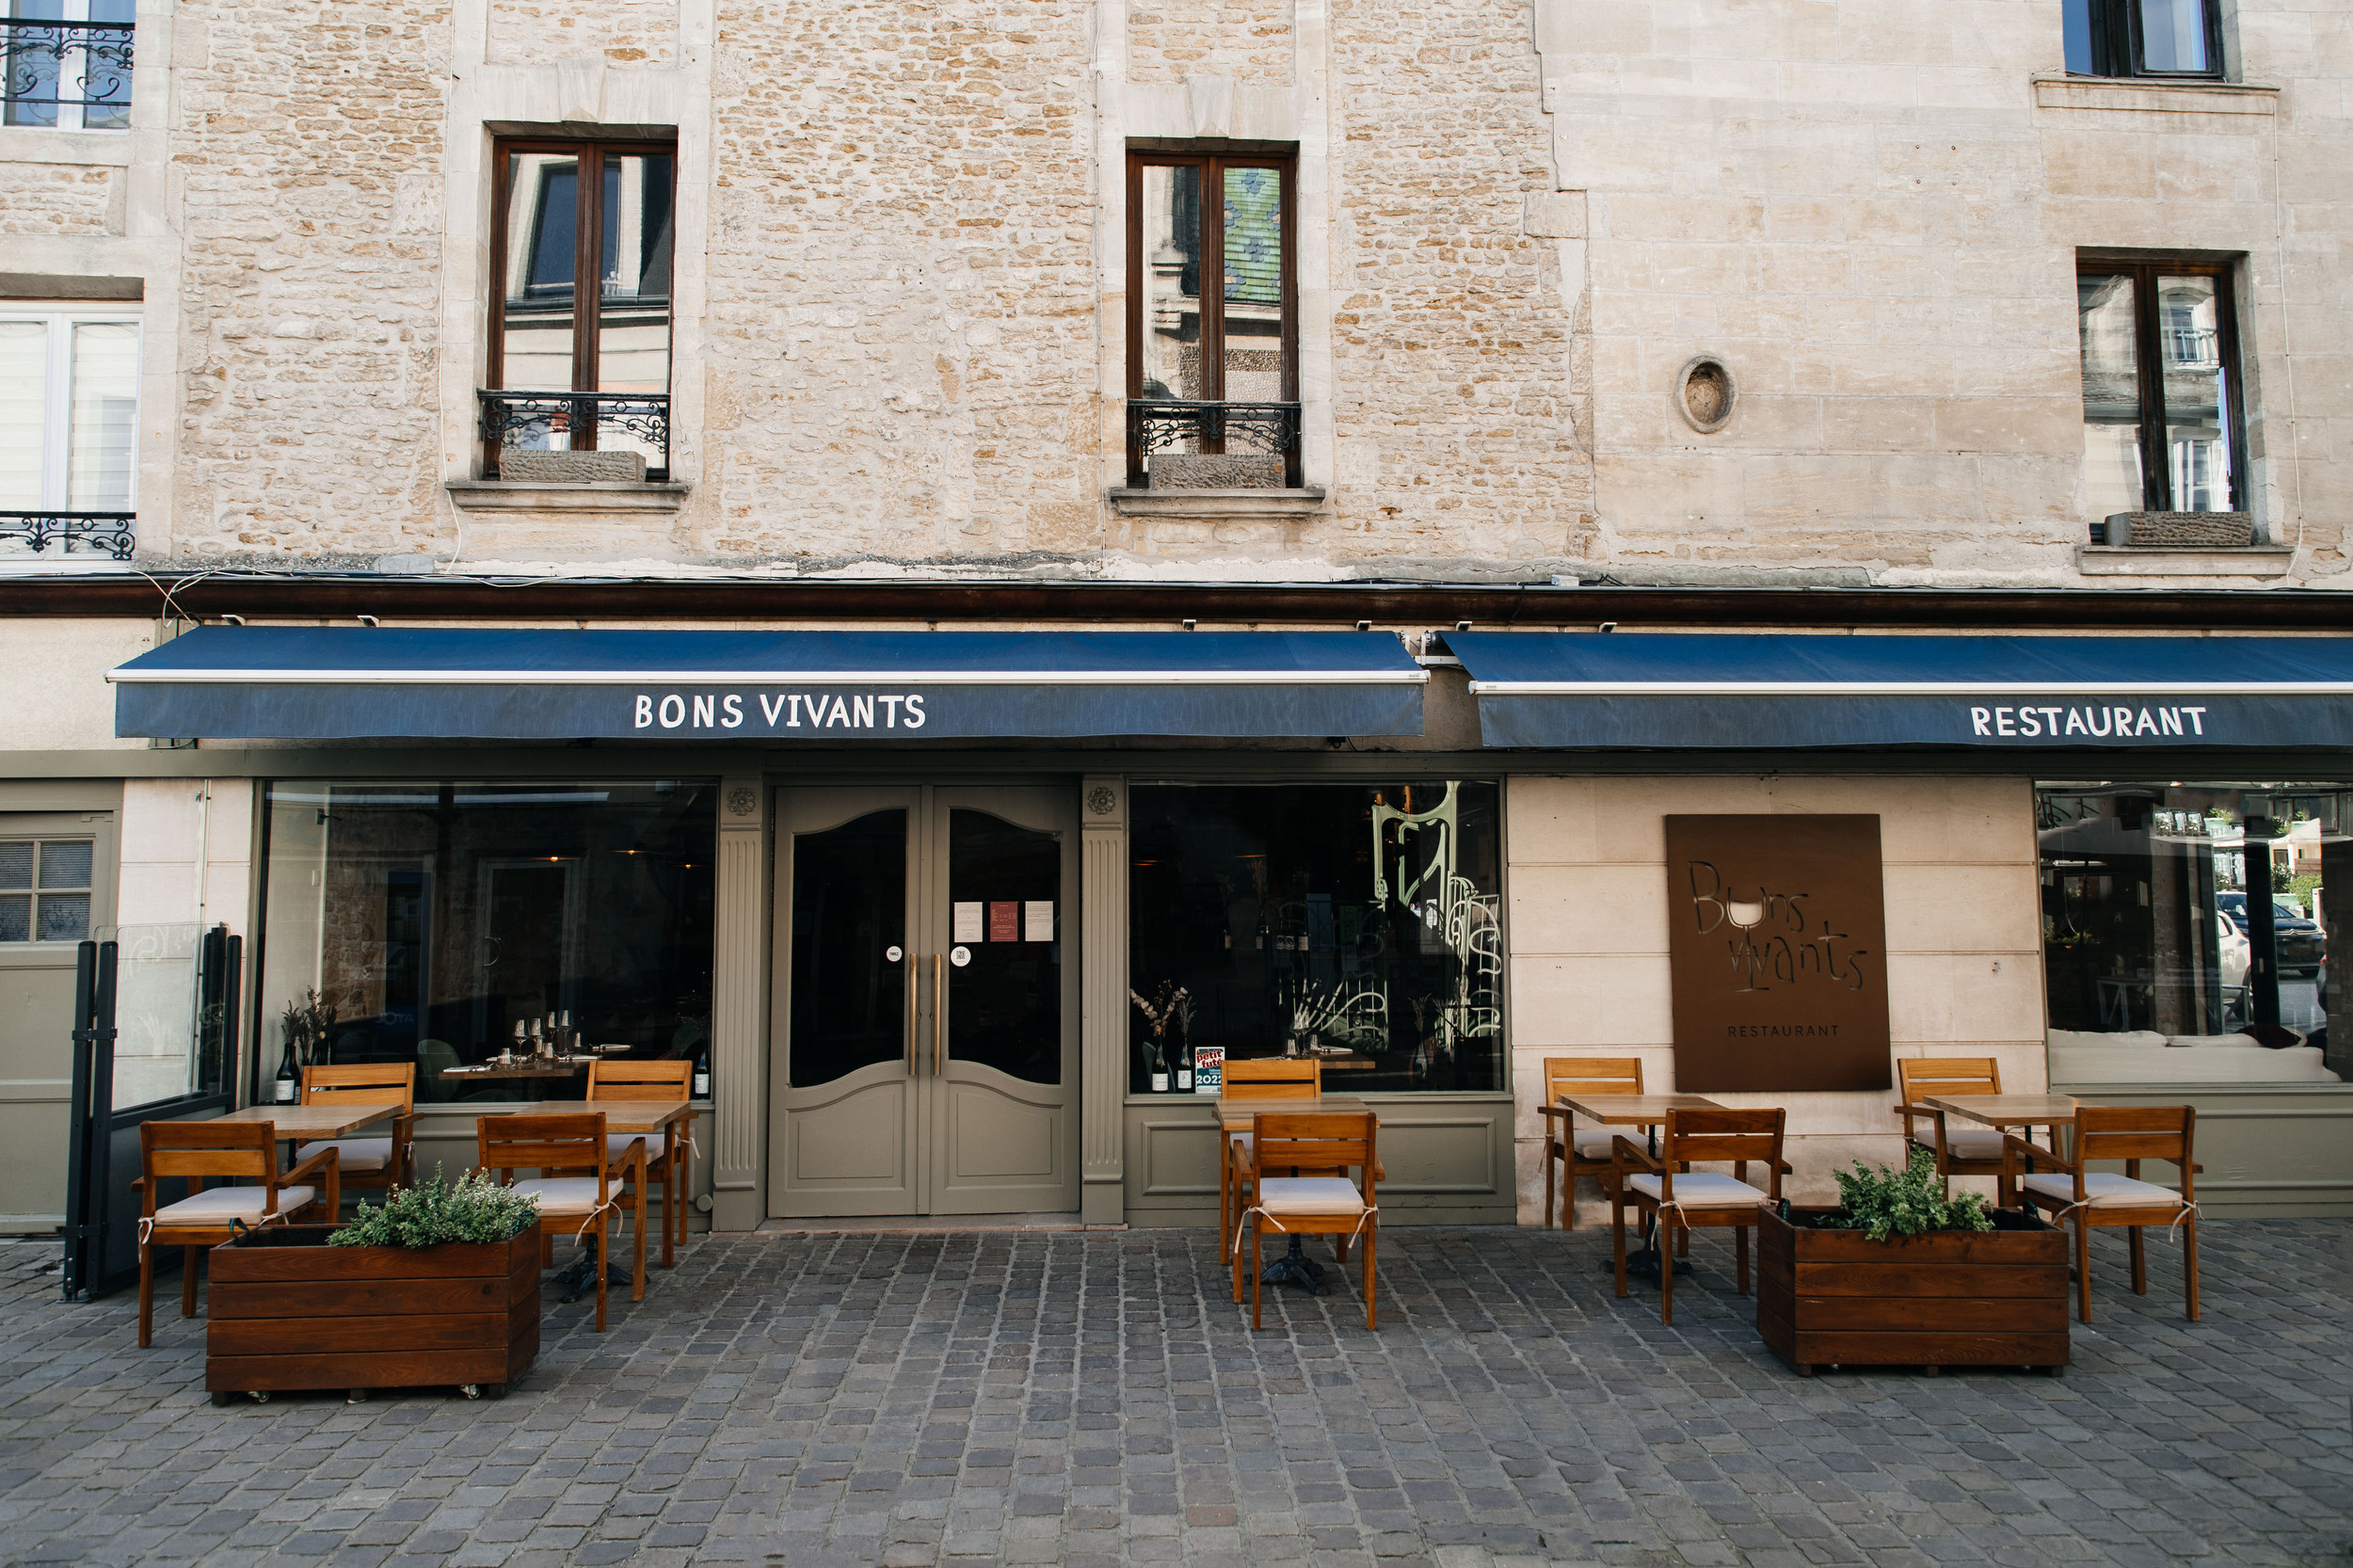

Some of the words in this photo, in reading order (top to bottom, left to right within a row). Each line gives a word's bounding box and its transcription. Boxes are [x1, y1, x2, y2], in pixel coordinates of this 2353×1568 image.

[635, 694, 744, 728] BONS
[760, 694, 926, 728] VIVANTS
[1971, 707, 2206, 737] RESTAURANT
[1728, 1025, 1838, 1036] RESTAURANT
[1196, 1049, 1222, 1063] petit
